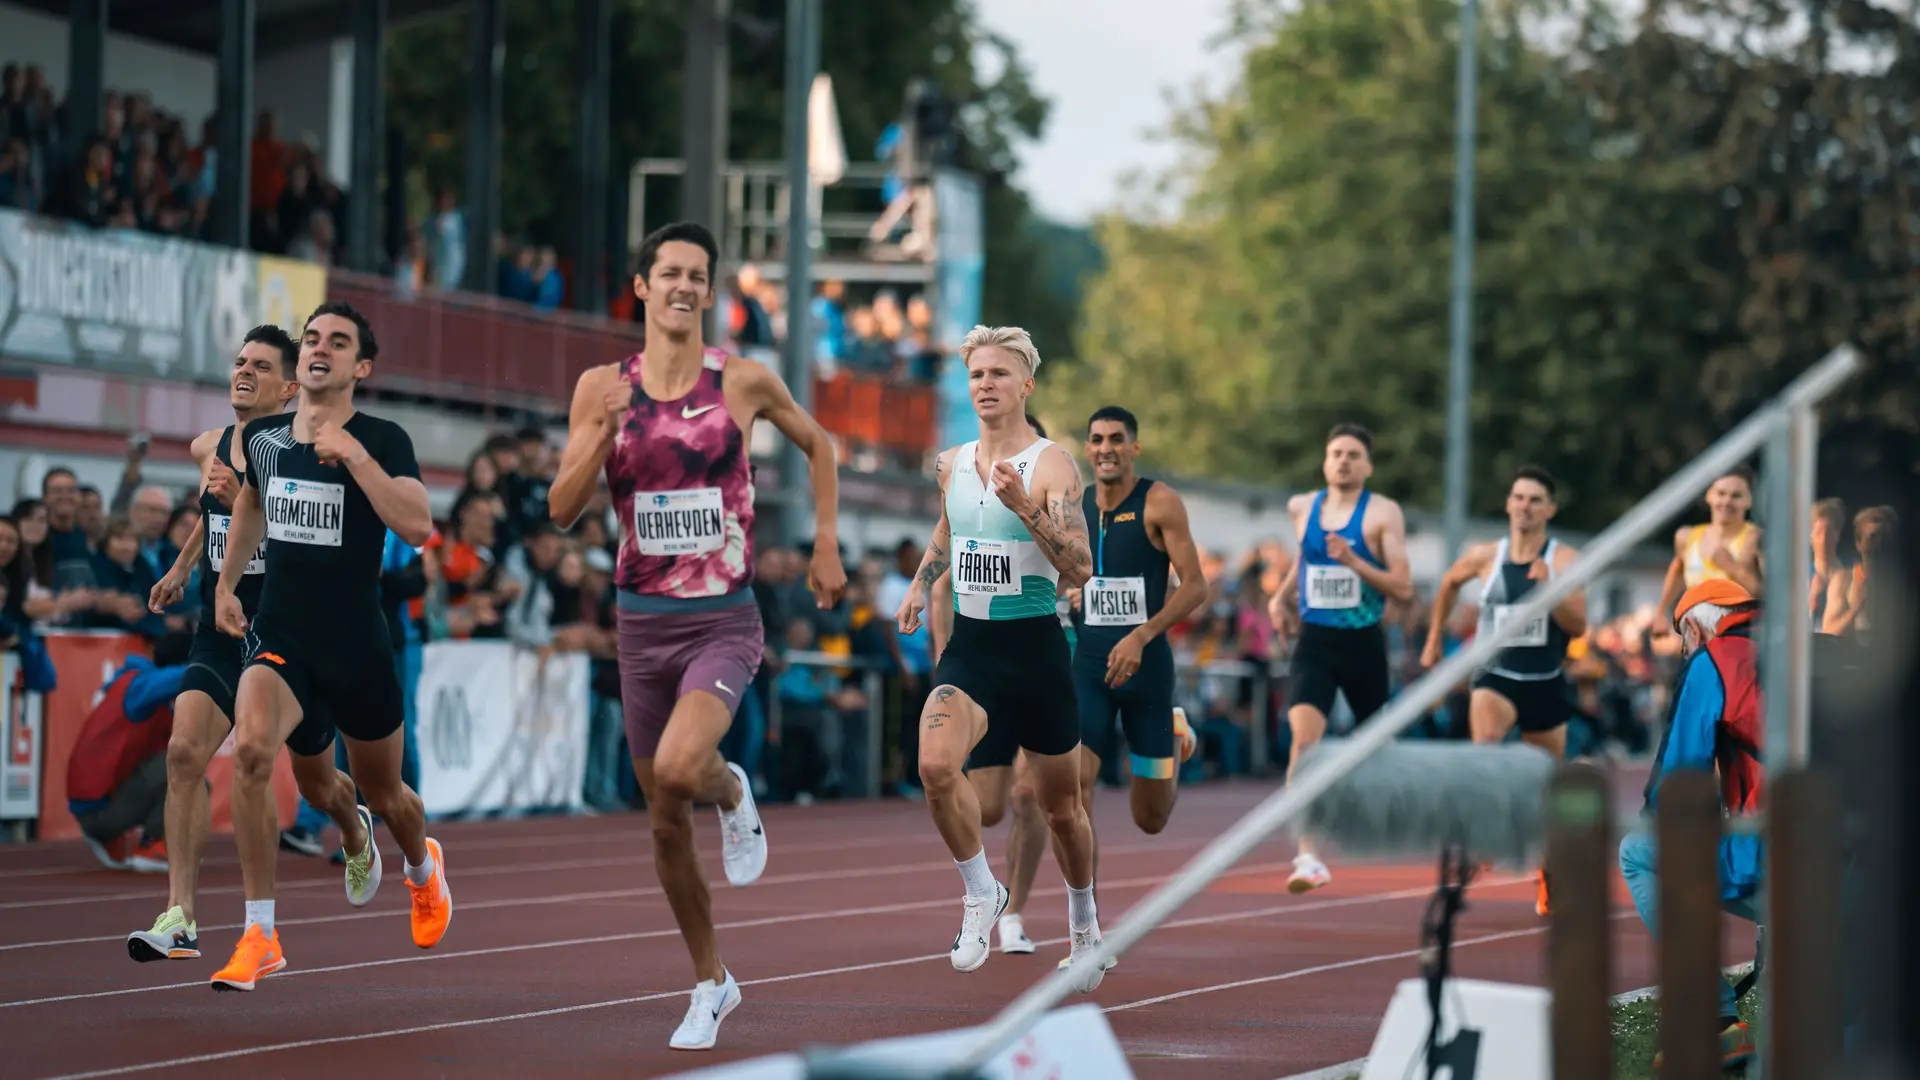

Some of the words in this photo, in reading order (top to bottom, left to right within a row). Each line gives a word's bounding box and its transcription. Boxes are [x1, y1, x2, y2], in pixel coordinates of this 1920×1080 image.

[268, 496, 341, 530] VERMEULEN
[637, 508, 721, 540] VERHEYDEN
[284, 530, 315, 541] REHLINGEN
[958, 552, 1011, 584] FARKEN
[967, 584, 998, 593] REHLINGEN
[1090, 590, 1138, 615] MESLEK
